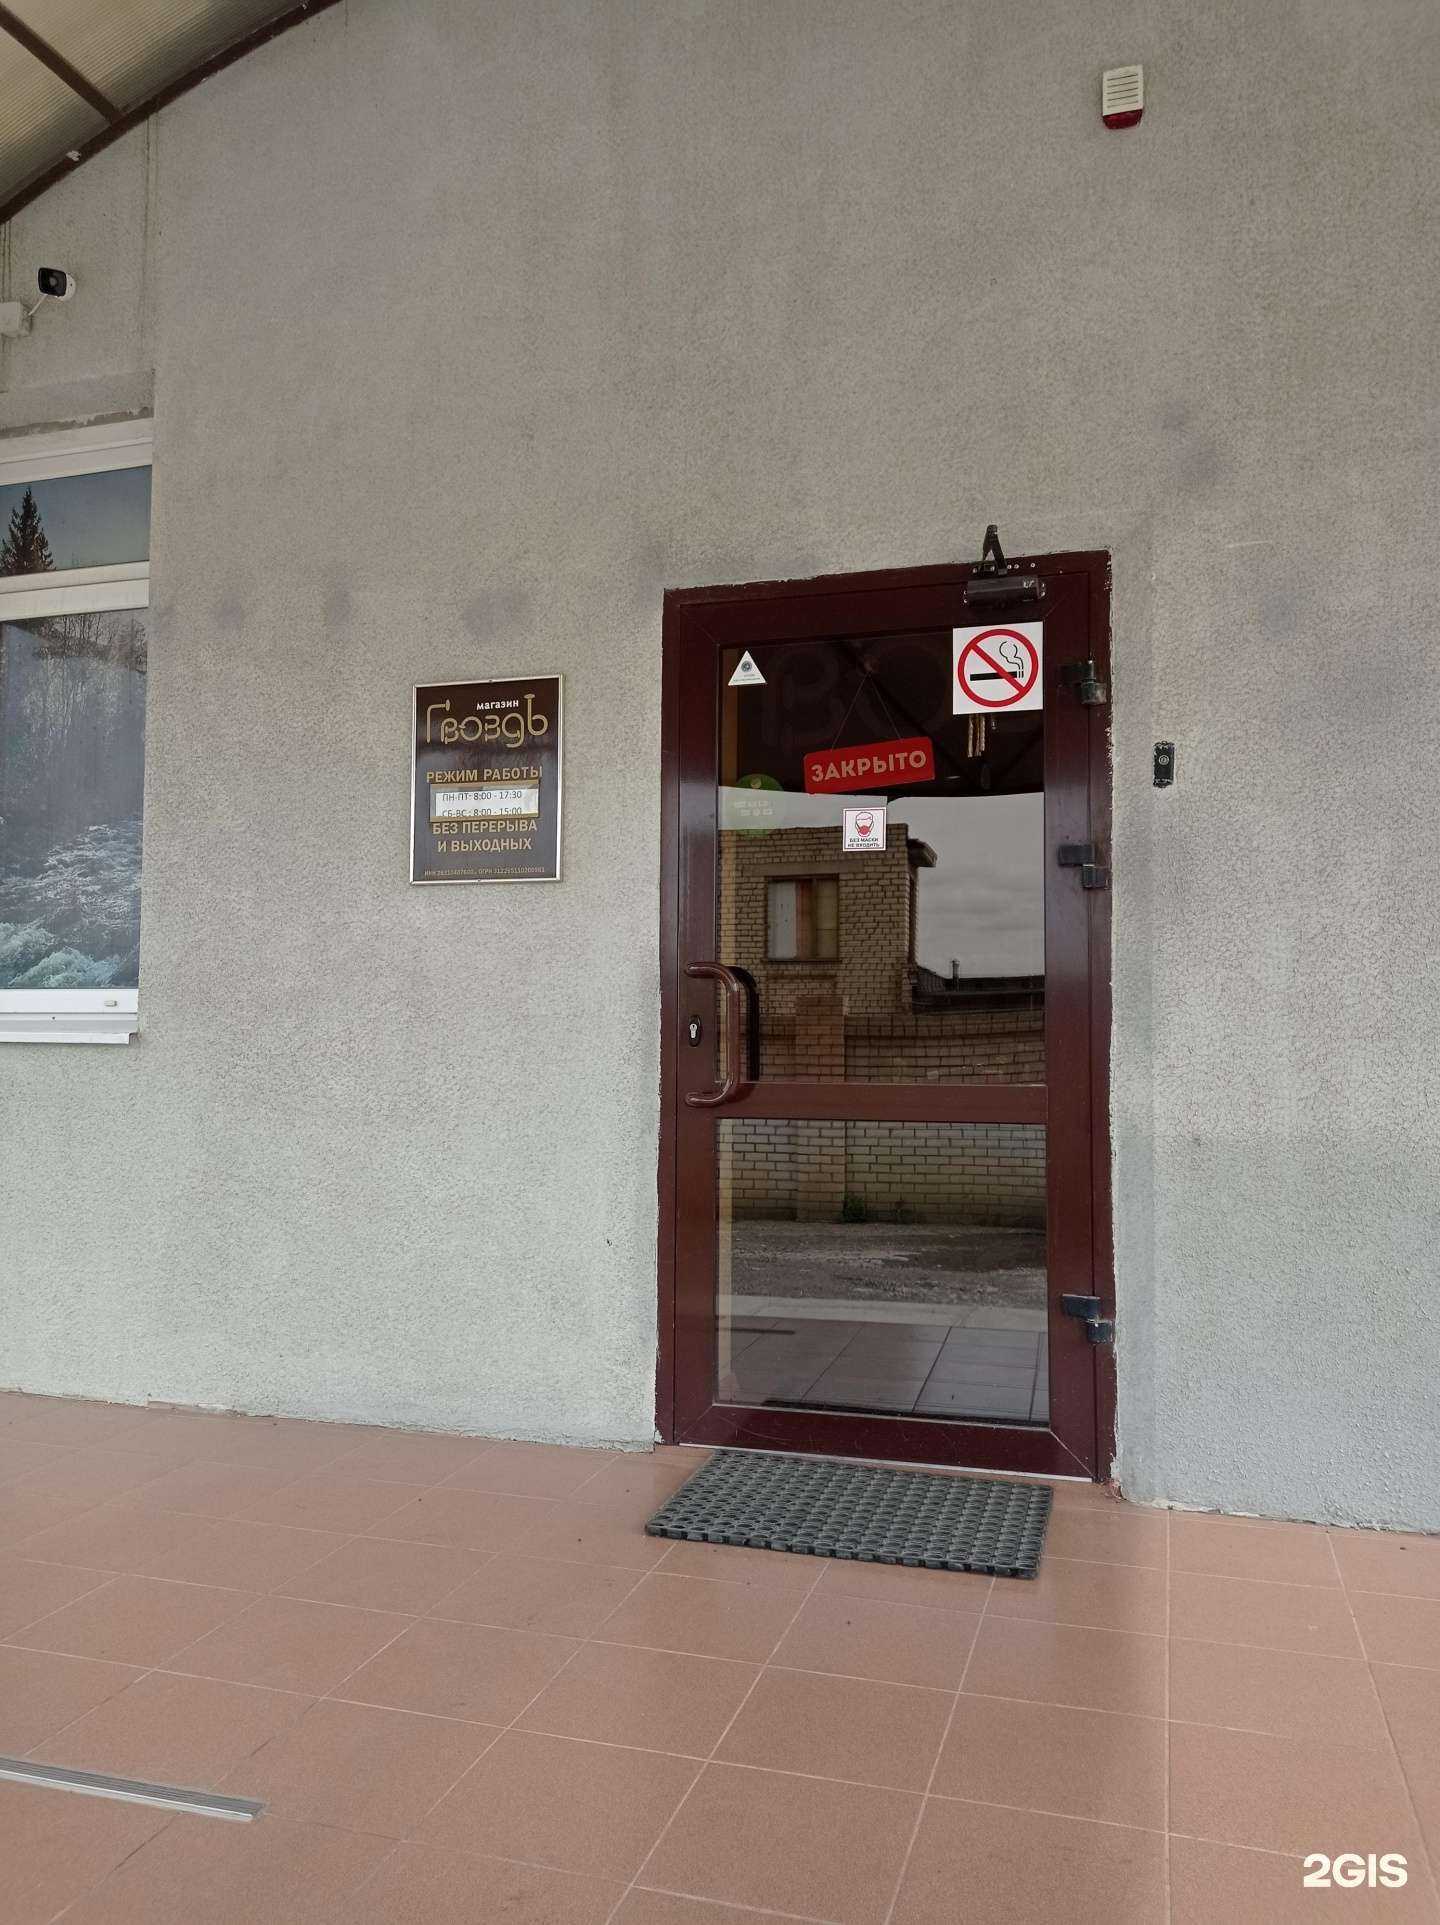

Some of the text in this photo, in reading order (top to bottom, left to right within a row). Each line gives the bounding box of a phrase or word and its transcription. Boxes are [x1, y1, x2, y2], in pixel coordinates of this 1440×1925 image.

[476, 699, 519, 711] магазин
[426, 765, 542, 783] РЕЖИМ РАБОТЫ
[811, 750, 927, 782] ЗАКРЫТО
[473, 791, 492, 801] 8:00
[499, 790, 522, 800] 17:30
[499, 806, 522, 816] 15:00
[432, 819, 538, 835] БЕЗ ПЕРЕРЫВА
[438, 837, 532, 853] И ВЫХОДНЫХ
